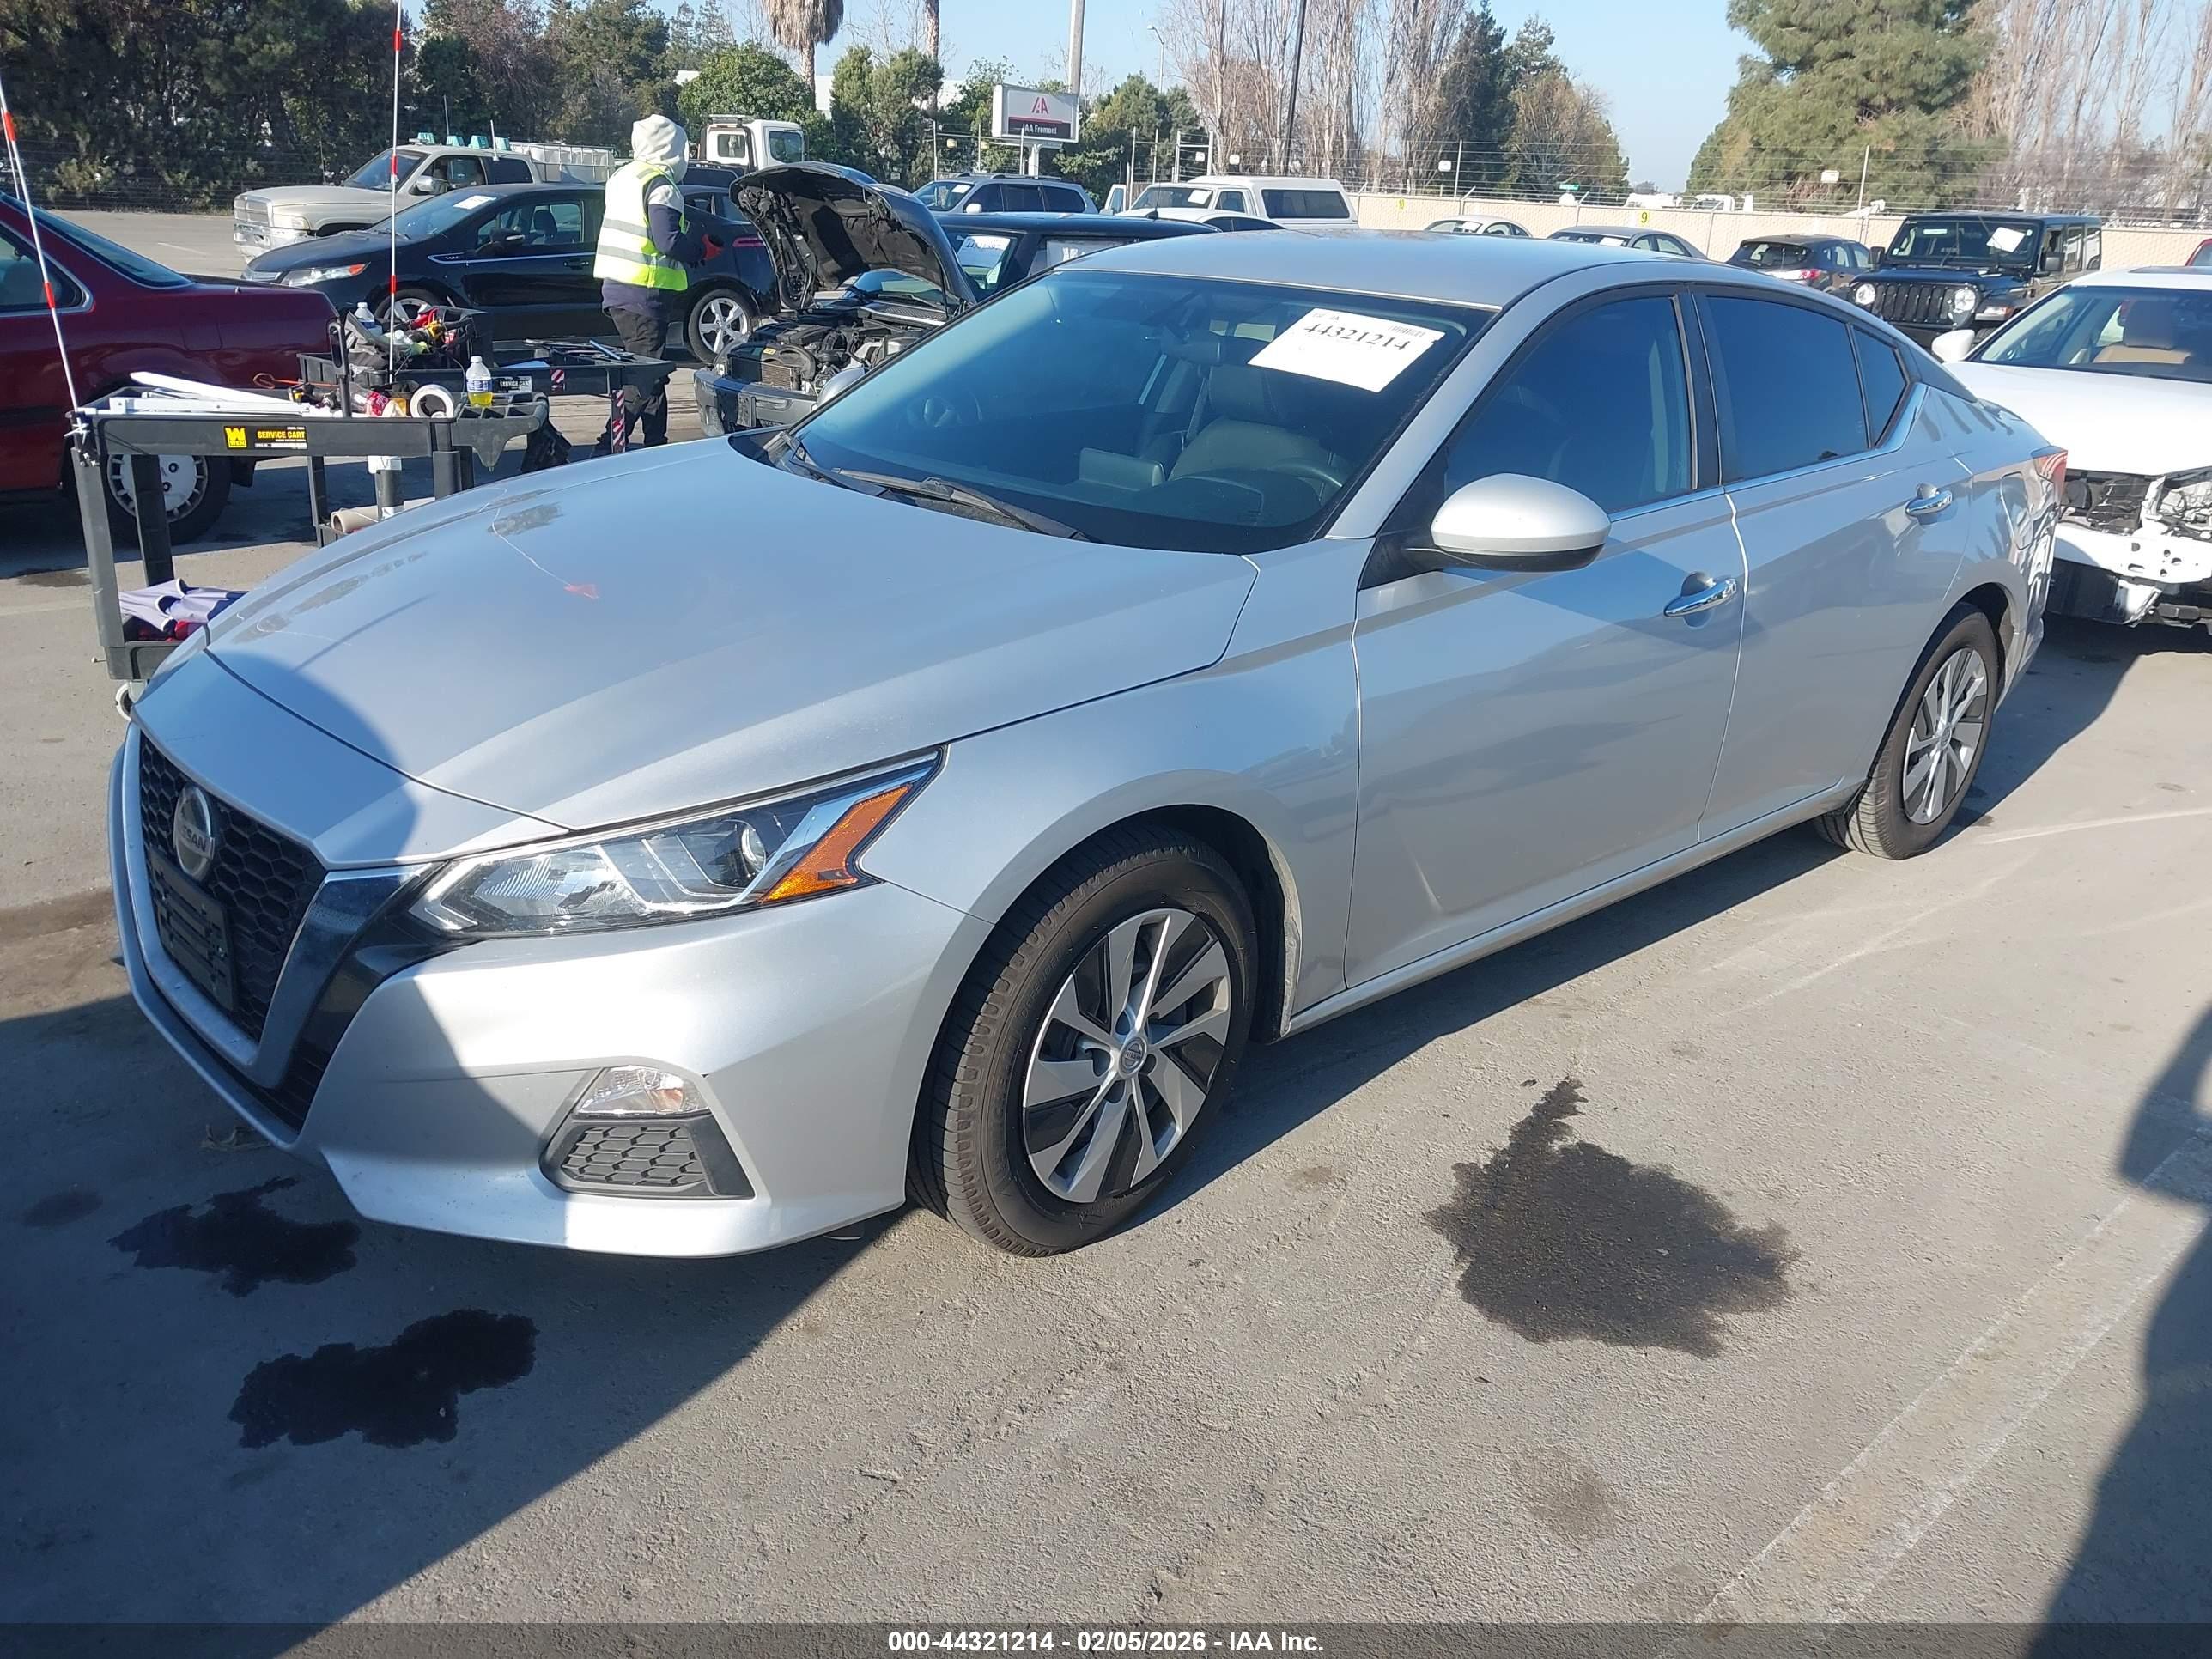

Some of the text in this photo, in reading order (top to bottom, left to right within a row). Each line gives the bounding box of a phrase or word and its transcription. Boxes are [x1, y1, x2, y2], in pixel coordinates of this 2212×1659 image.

[1035, 125, 1057, 134] Fremont
[1641, 211, 1649, 224] 9
[1304, 323, 1411, 350] 44321214
[257, 430, 287, 439] SERVICE
